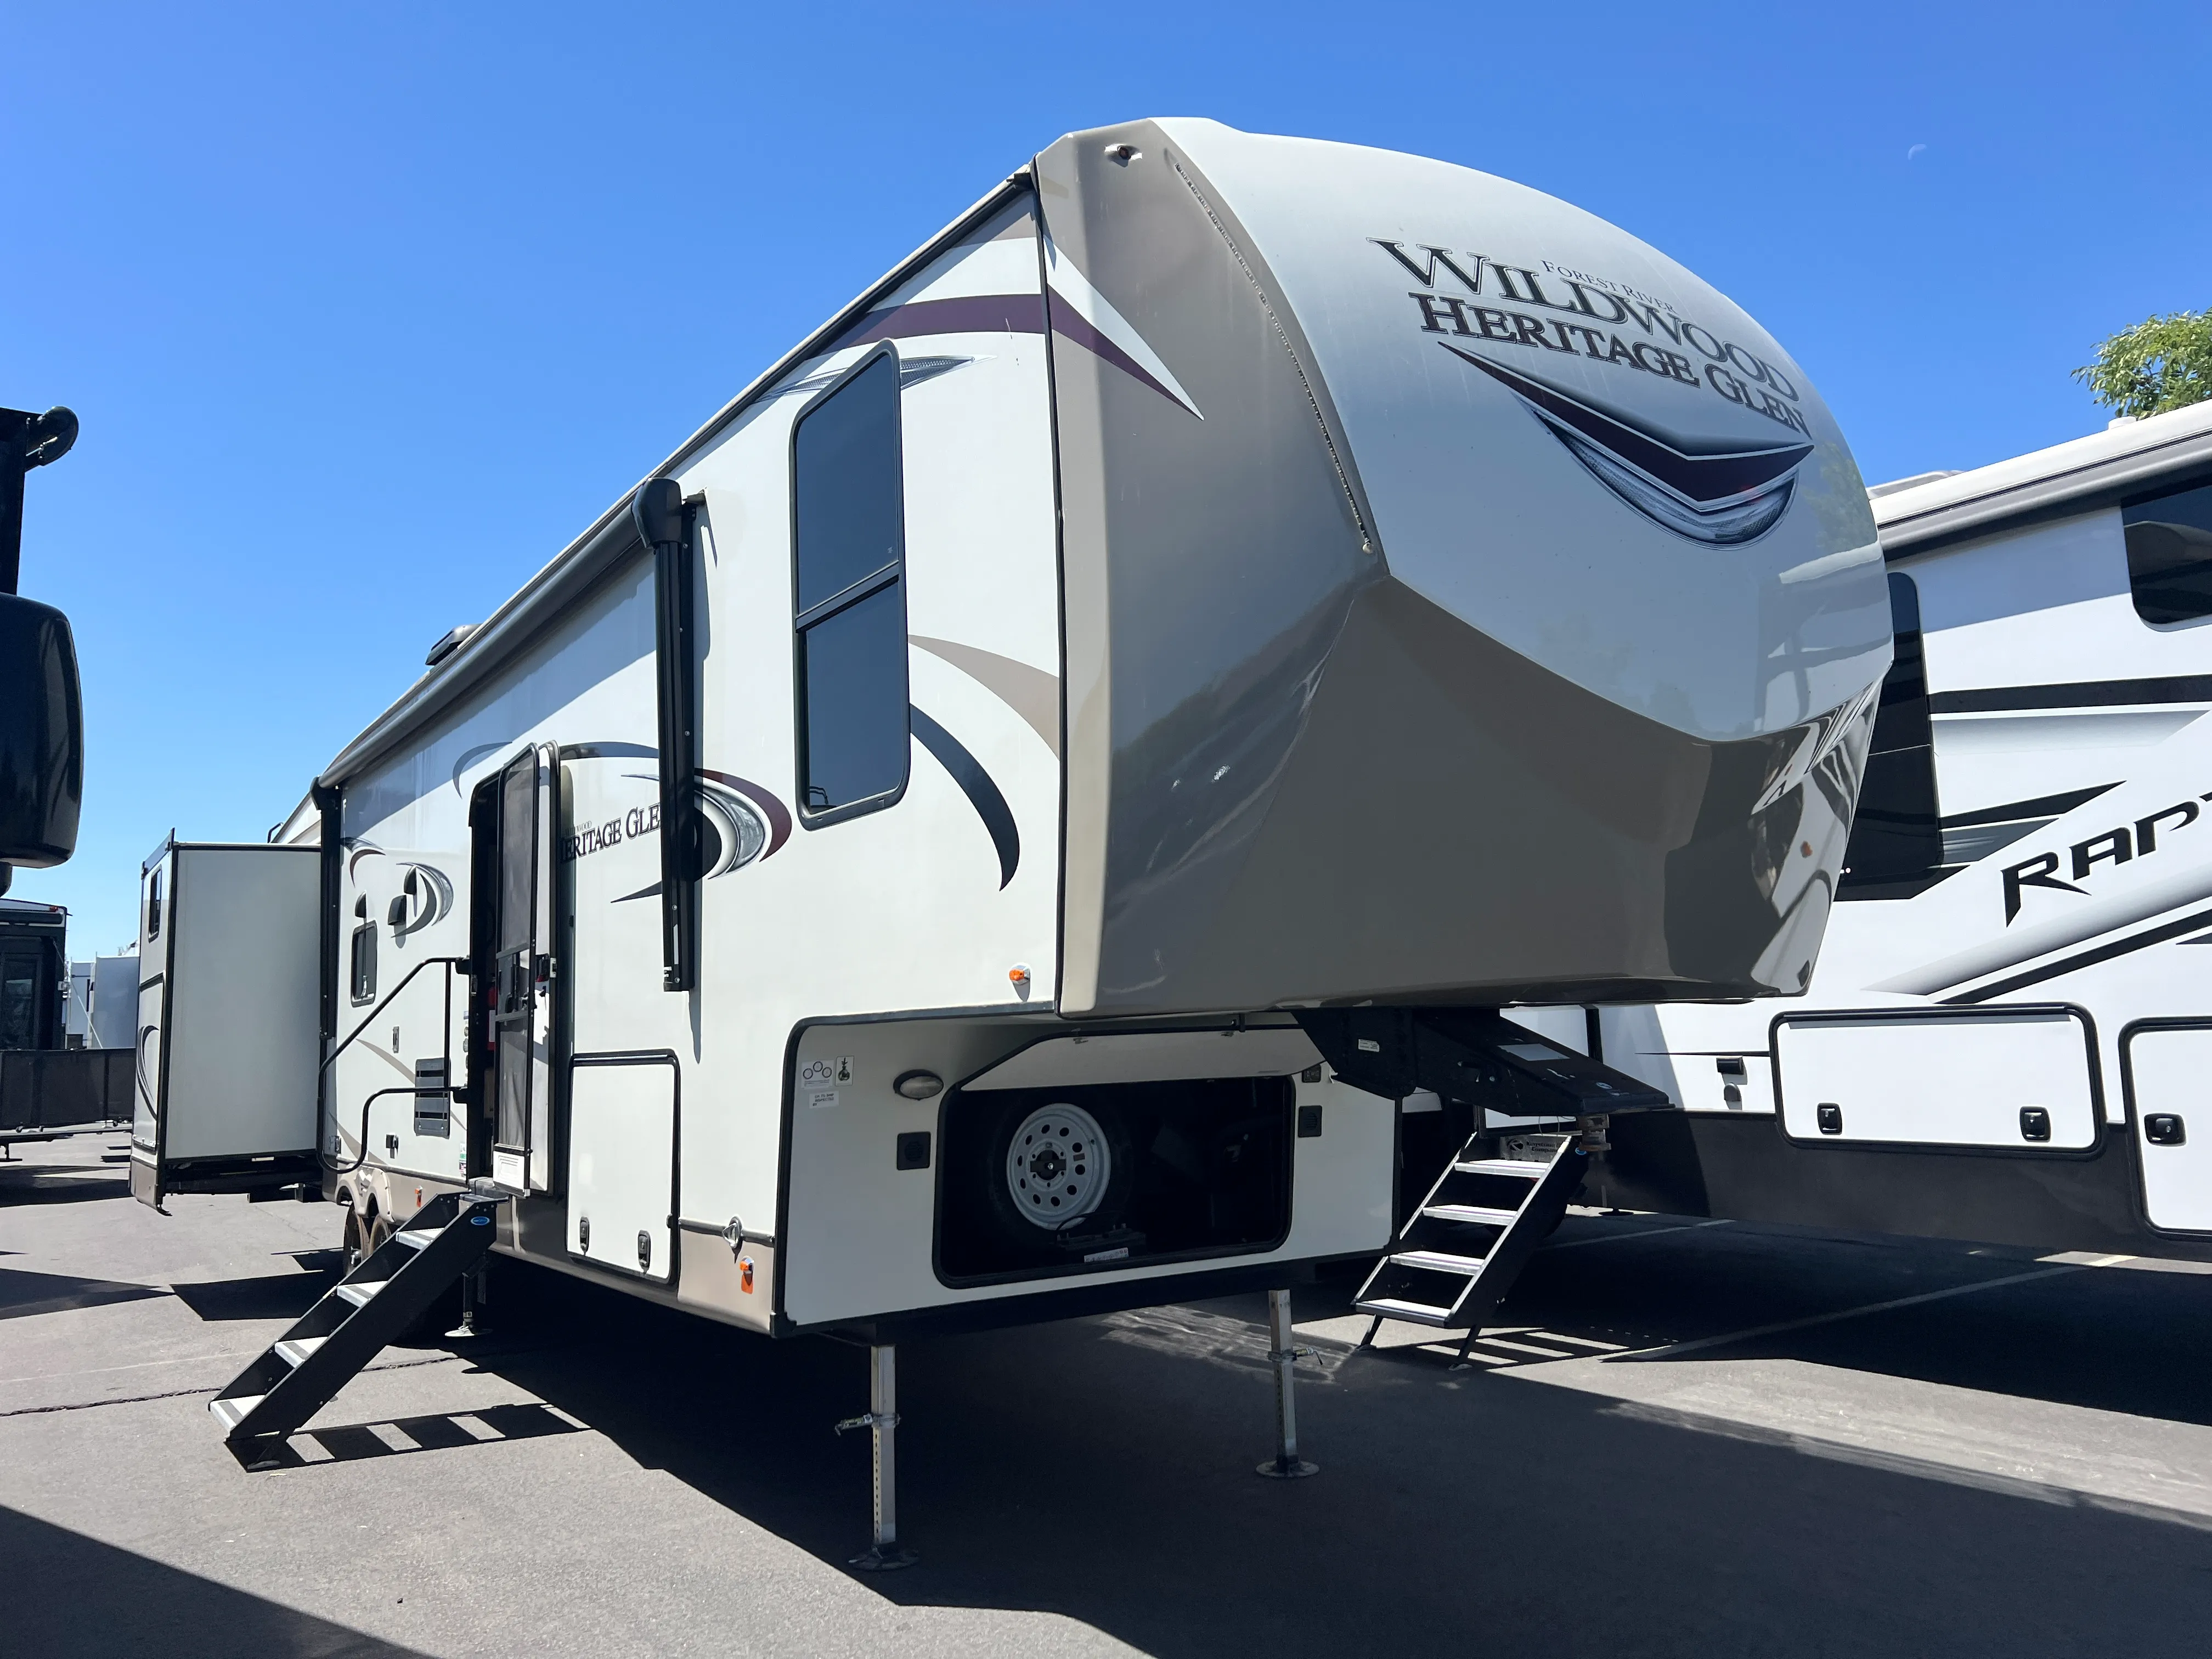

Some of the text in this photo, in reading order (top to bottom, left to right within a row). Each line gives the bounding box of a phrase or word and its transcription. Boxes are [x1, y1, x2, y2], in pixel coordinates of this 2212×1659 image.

[1366, 236, 1800, 402] WILDWOOD
[1541, 259, 1678, 314] FOREST RIVER
[1408, 292, 1813, 439] HERITAGE GLEN
[626, 802, 662, 839] GLE
[2000, 791, 2212, 928] RAP
